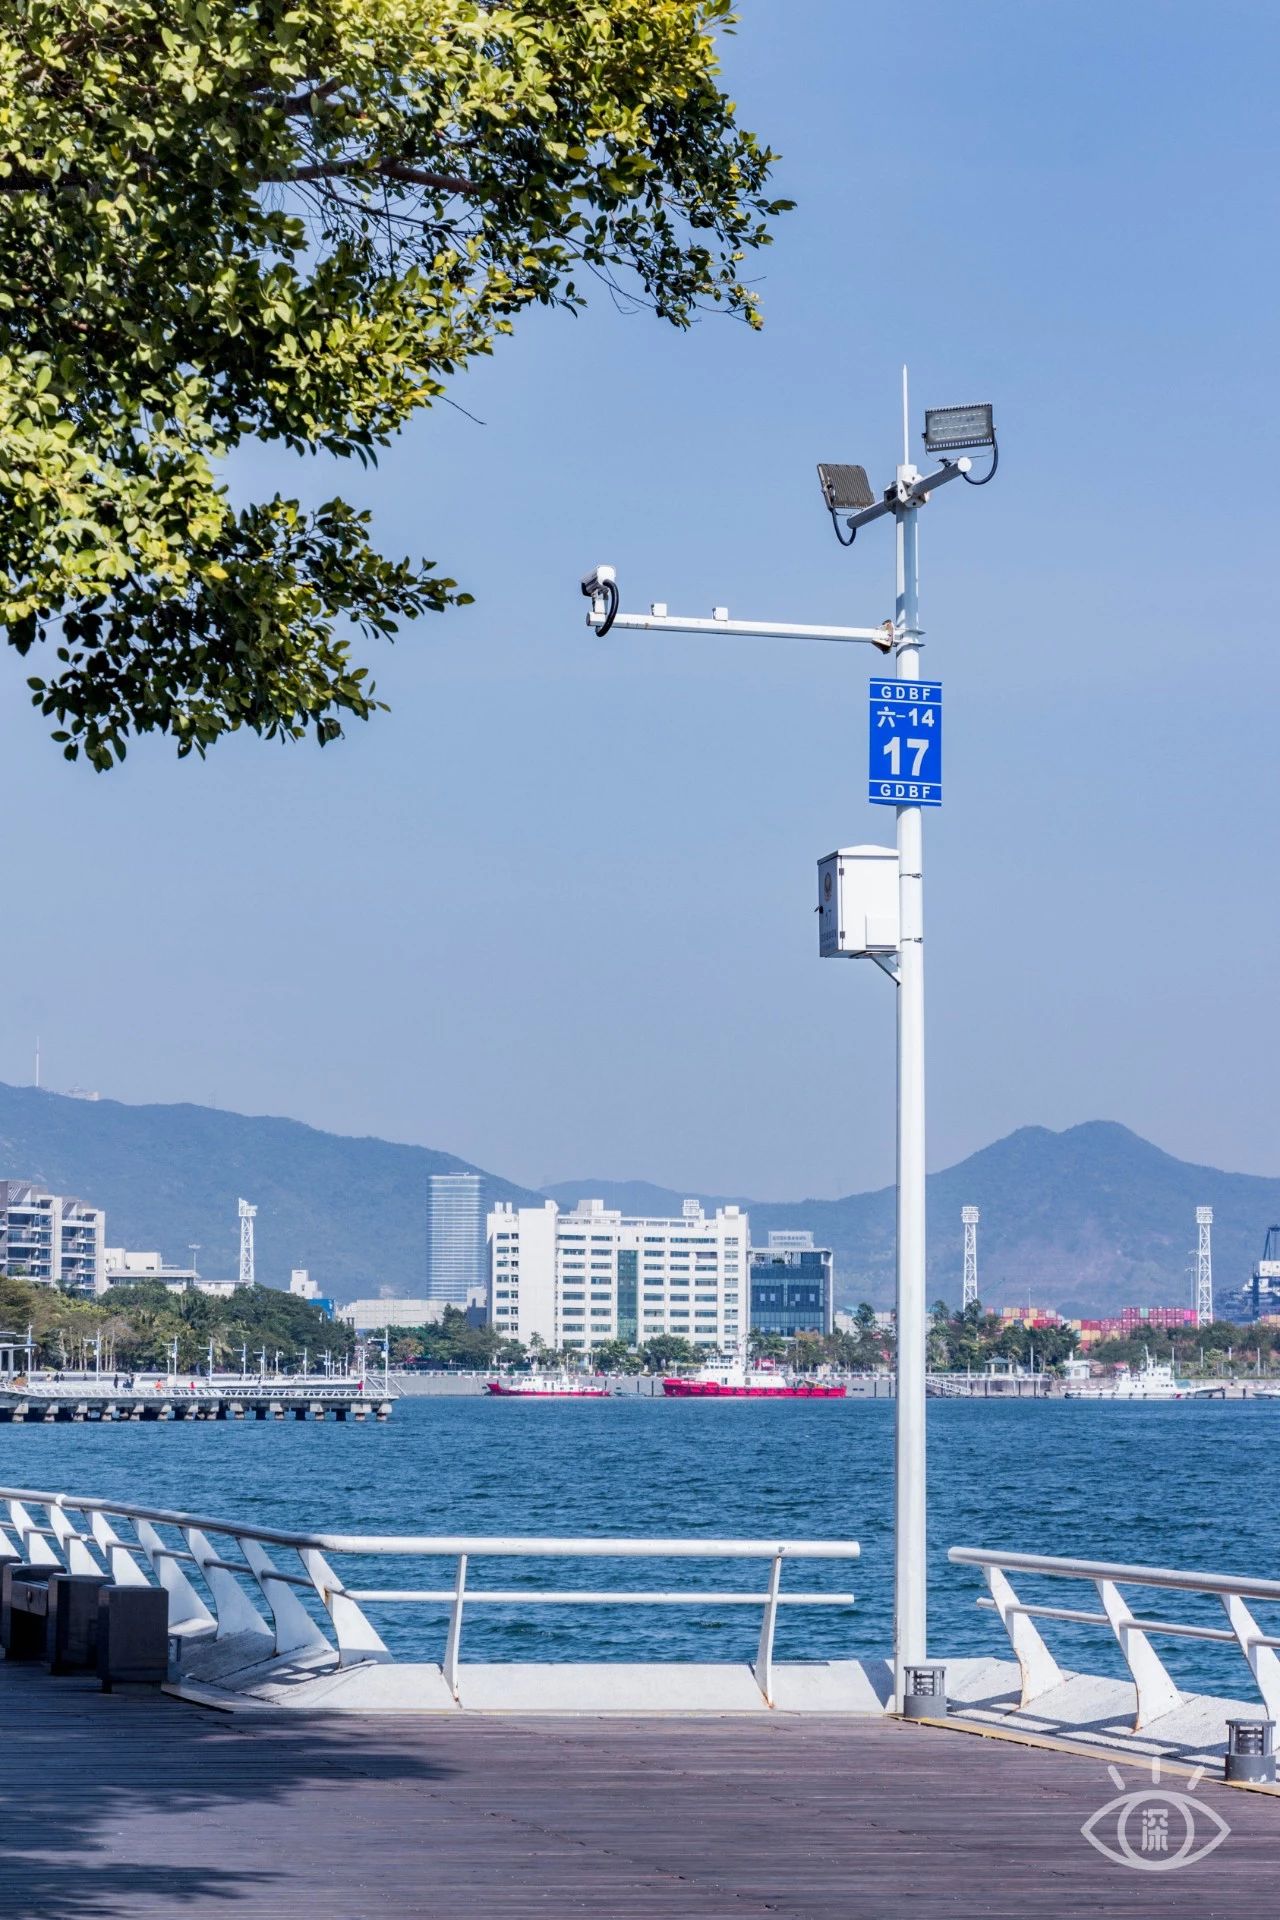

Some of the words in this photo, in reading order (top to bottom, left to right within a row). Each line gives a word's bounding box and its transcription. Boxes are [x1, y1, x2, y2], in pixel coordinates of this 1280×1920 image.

[881, 686, 931, 701] GDBF
[883, 736, 930, 777] 17
[880, 783, 931, 799] GDBF
